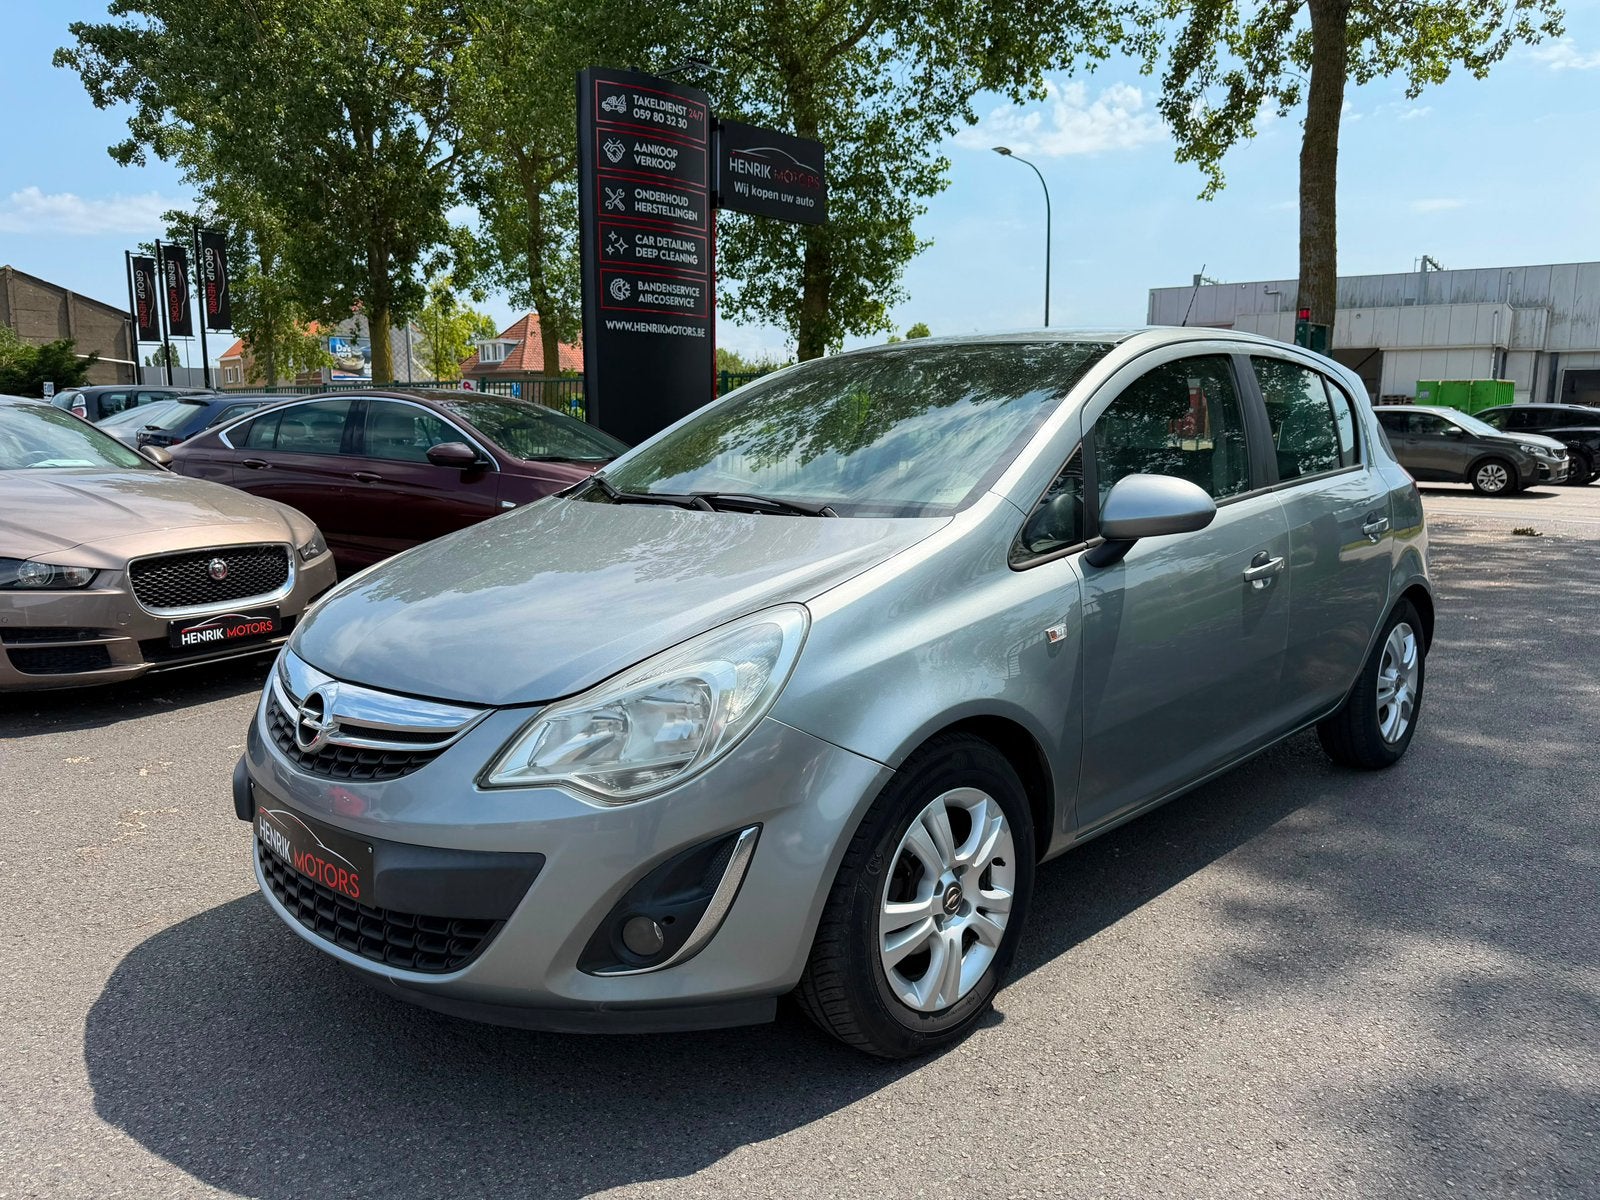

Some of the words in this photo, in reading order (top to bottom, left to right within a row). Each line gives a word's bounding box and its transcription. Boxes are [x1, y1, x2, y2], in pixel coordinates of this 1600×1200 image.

[633, 94, 687, 116] TAKELDIENST
[689, 109, 704, 121] 24/7
[633, 108, 650, 120] 059
[653, 112, 664, 123] 80
[666, 115, 676, 125] 32
[678, 118, 688, 129] 30
[633, 142, 678, 158] AANKOOP
[634, 154, 676, 171] VERKOOP
[729, 157, 771, 179] HENRIK
[774, 169, 820, 189] MOTORS
[635, 188, 689, 206] ONDERHOUD
[734, 181, 749, 197] Wij
[751, 185, 779, 200] kopen
[781, 193, 794, 203] uw
[795, 196, 815, 208] auto
[635, 201, 698, 221] HERSTELLINGEN
[636, 234, 654, 246] CAR
[657, 237, 696, 252] DETAILING
[205, 247, 215, 281] GROUP
[636, 247, 658, 259] DEEP
[660, 250, 698, 265] CLEANING
[136, 270, 145, 299] GROUP
[167, 260, 177, 288] HENRIK
[208, 282, 217, 314] HENRIK
[638, 281, 700, 297] BANDENSERVICE
[638, 293, 695, 308] AIRCOSERVICE
[138, 300, 148, 328] HENRIK
[169, 290, 179, 322] MOTORS
[605, 320, 706, 338] WWW.HENRIKMOTORS.BE
[181, 628, 224, 645] HENRIK
[227, 620, 273, 638] MOTORS
[259, 816, 291, 863] HENRIK
[294, 847, 360, 898] MOTORS
